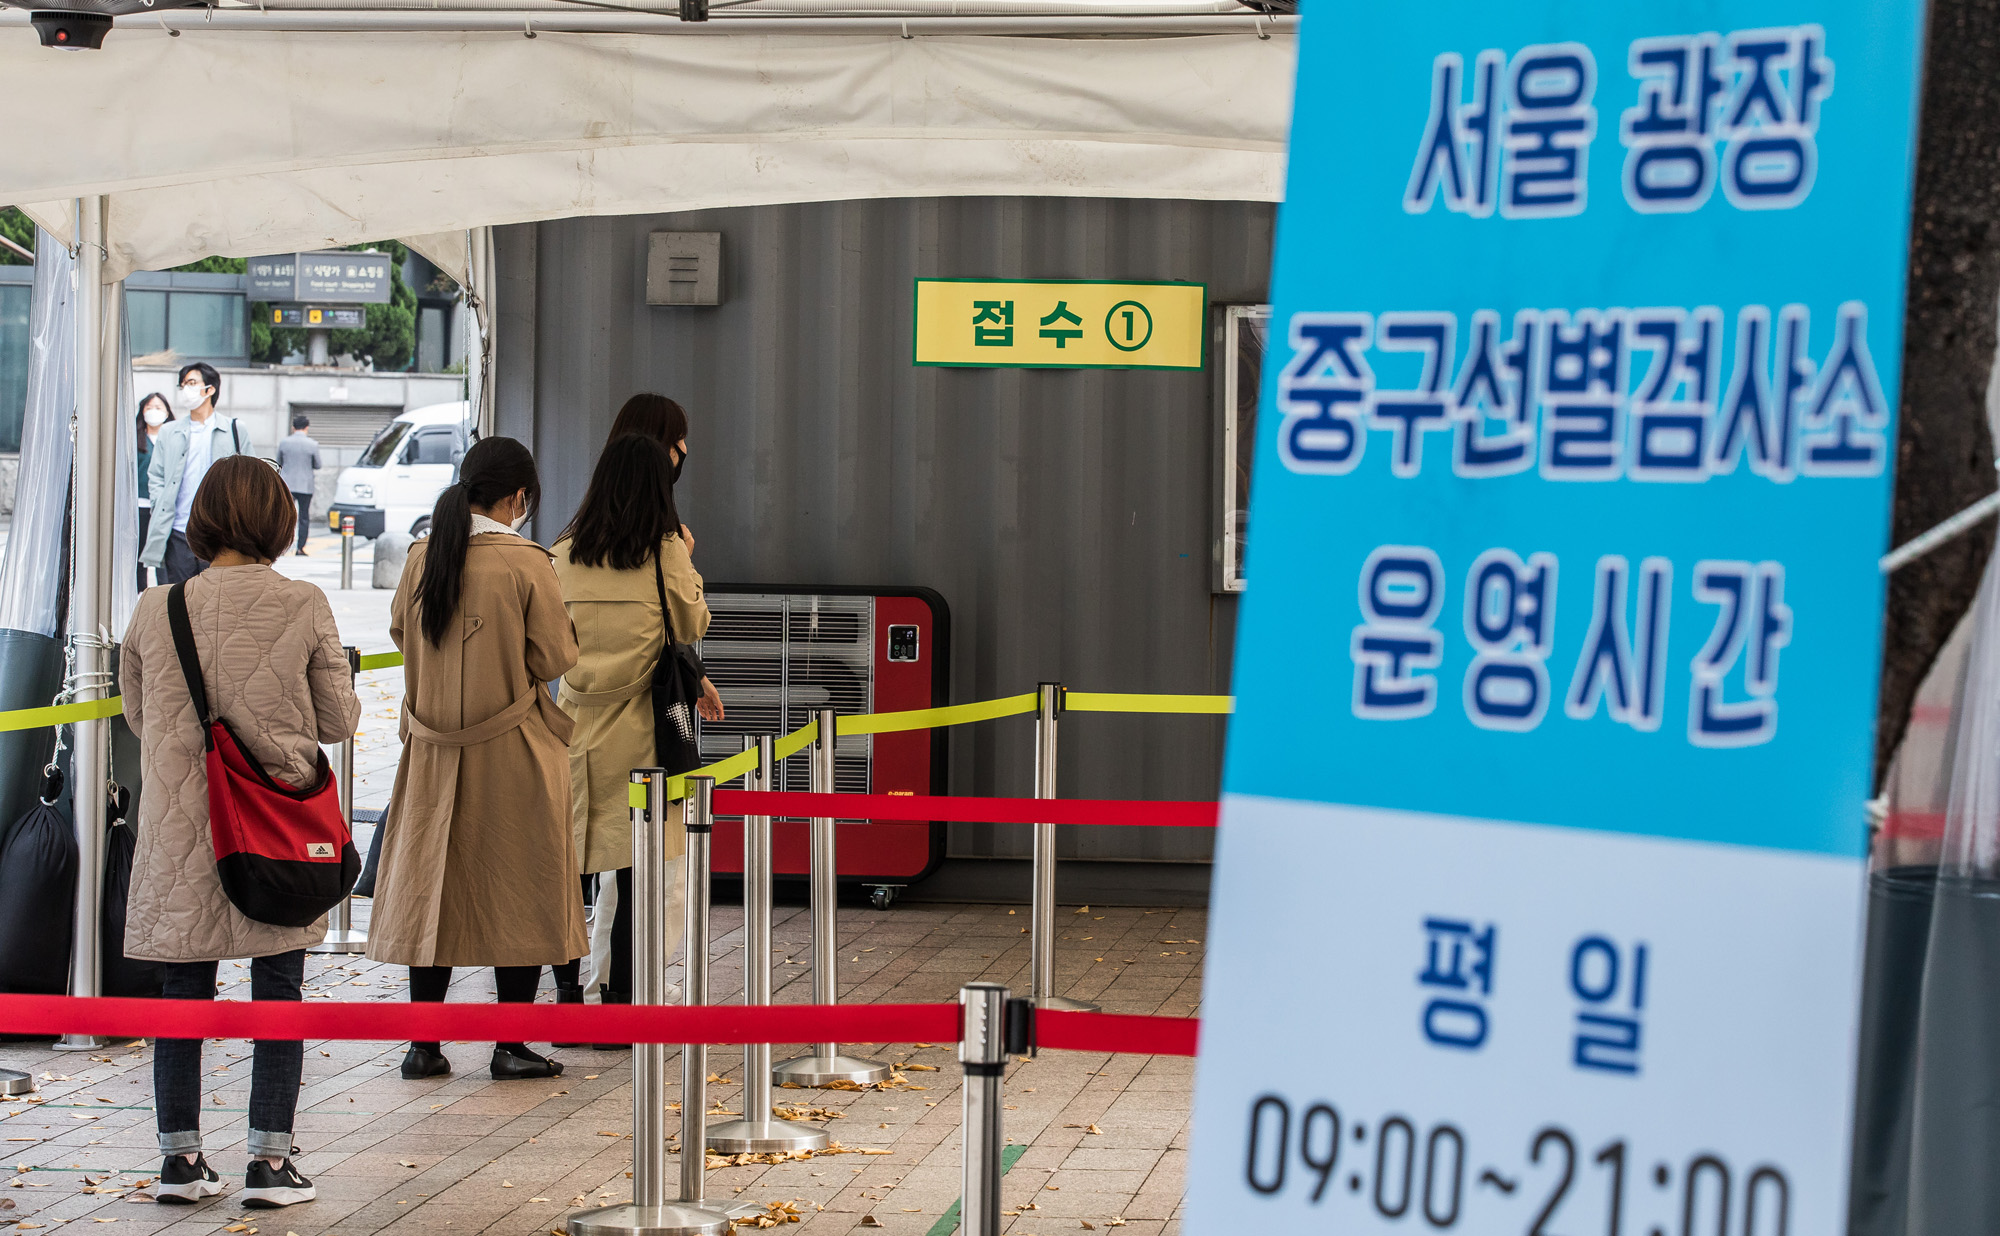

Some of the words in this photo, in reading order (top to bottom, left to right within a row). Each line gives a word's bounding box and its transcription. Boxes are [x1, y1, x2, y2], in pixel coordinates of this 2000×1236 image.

[1403, 42, 1597, 219] 서울
[1621, 25, 1834, 213] 광장
[1278, 300, 1890, 483] 중구선별검사소
[1350, 544, 1794, 749] 운영시간
